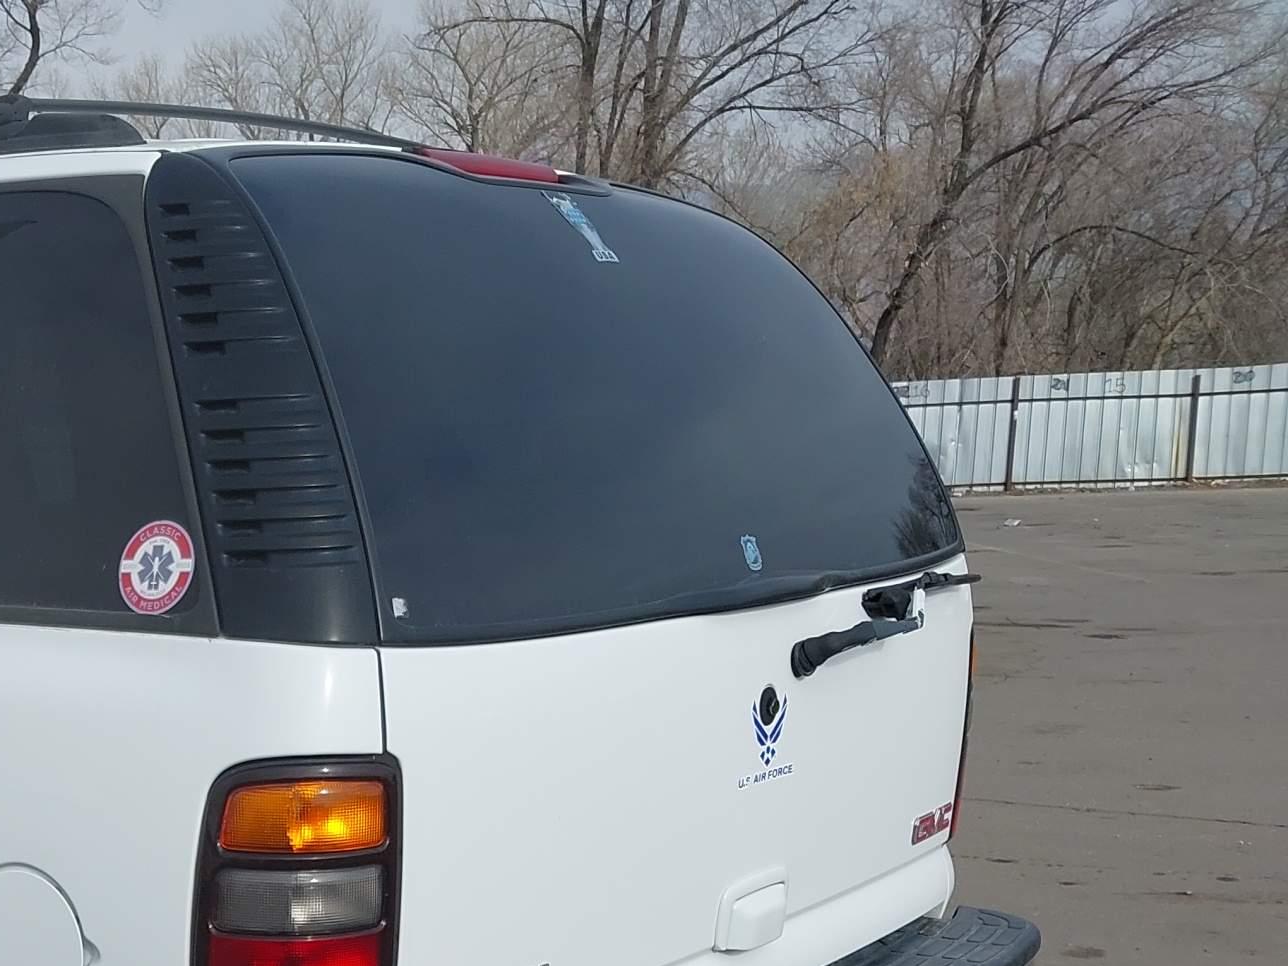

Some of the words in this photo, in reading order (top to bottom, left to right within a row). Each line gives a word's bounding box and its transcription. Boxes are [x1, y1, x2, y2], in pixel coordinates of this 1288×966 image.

[139, 526, 181, 542] CLASSIC
[125, 586, 138, 604] AIR
[139, 586, 183, 611] MEDICAL
[753, 772, 767, 784] AIR
[768, 764, 793, 780] FORCE
[911, 801, 953, 846] GMC
